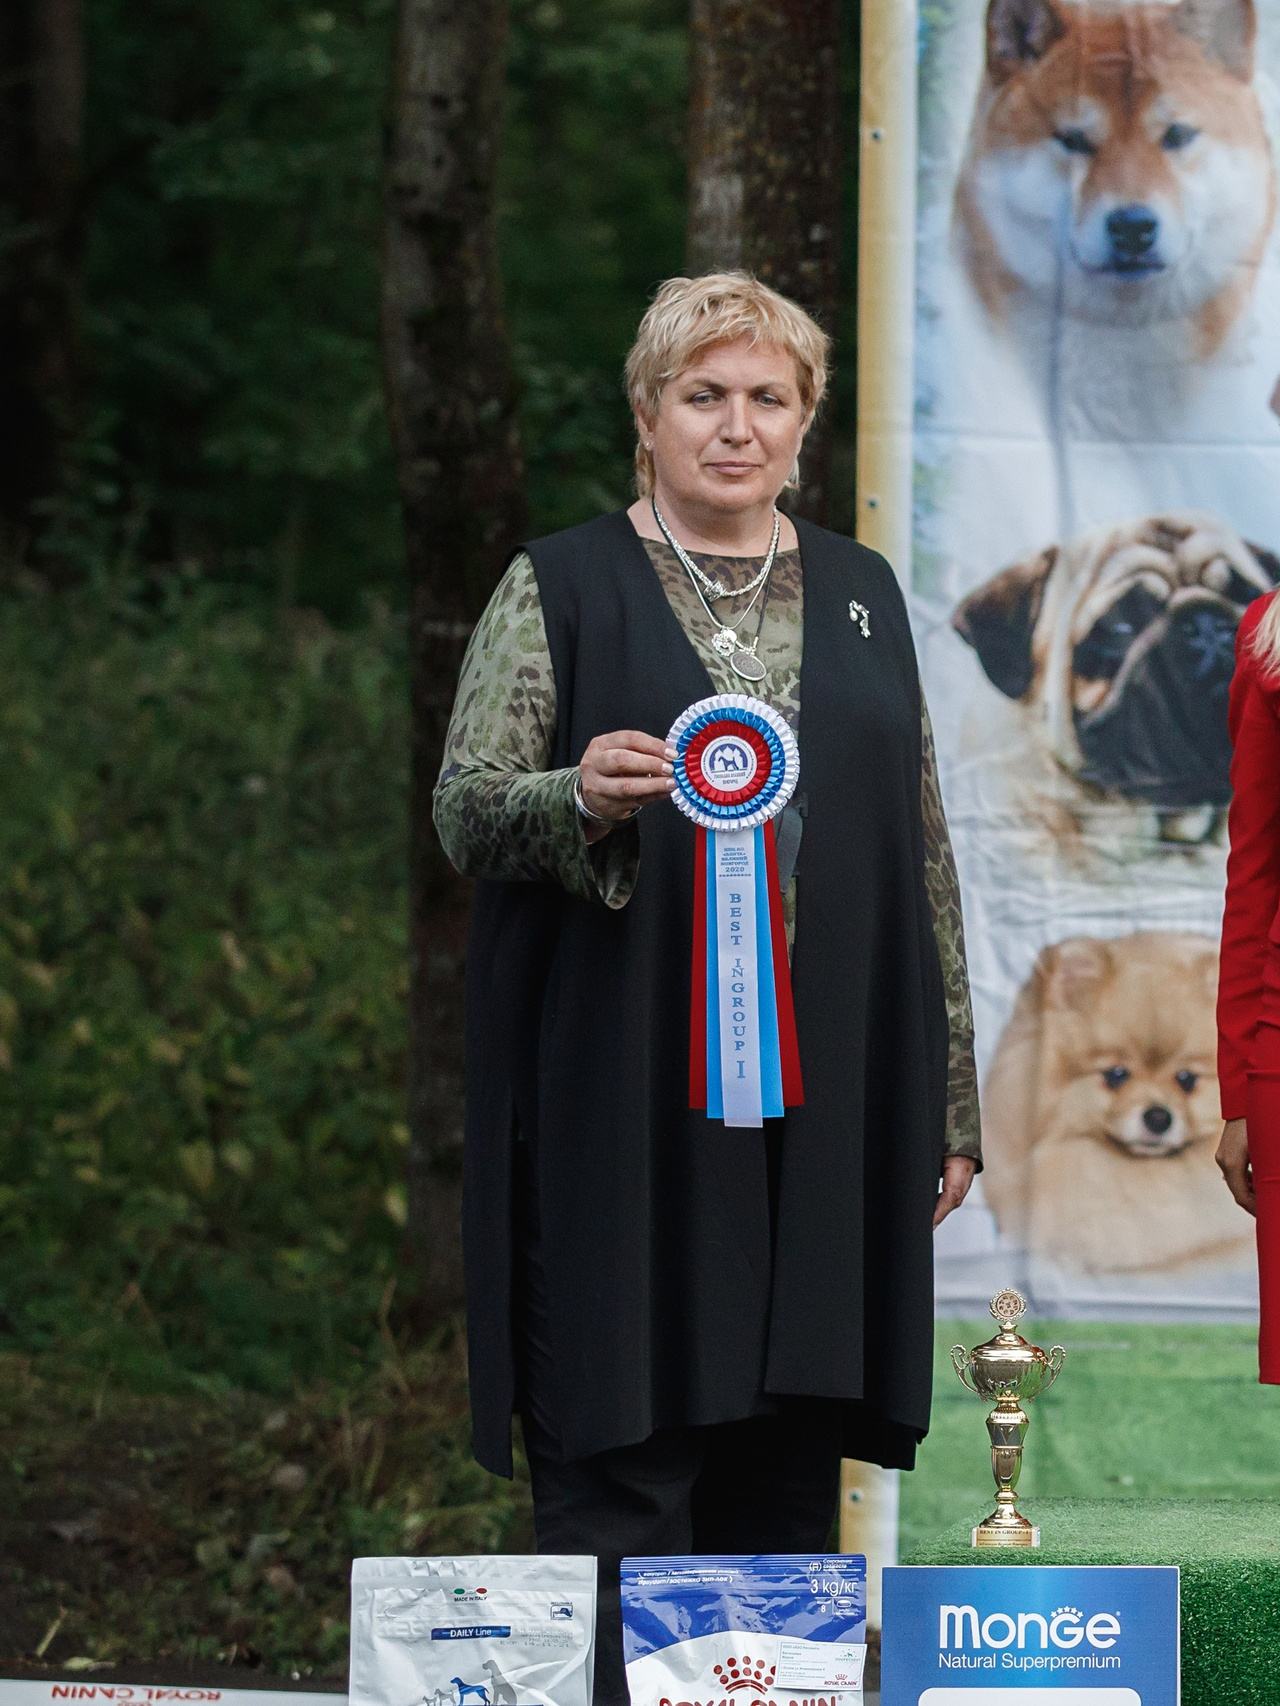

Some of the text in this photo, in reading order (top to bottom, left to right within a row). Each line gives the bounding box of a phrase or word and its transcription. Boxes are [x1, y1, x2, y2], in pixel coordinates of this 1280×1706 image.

[729, 892, 743, 946] BEST
[810, 1578, 858, 1597] 3 kg/кг
[820, 1604, 827, 1613] 8
[450, 1628, 492, 1638] DAILY Line
[938, 1652, 1121, 1671] Natural Superpremium
[51, 1684, 221, 1701] ROYAL CANIN
